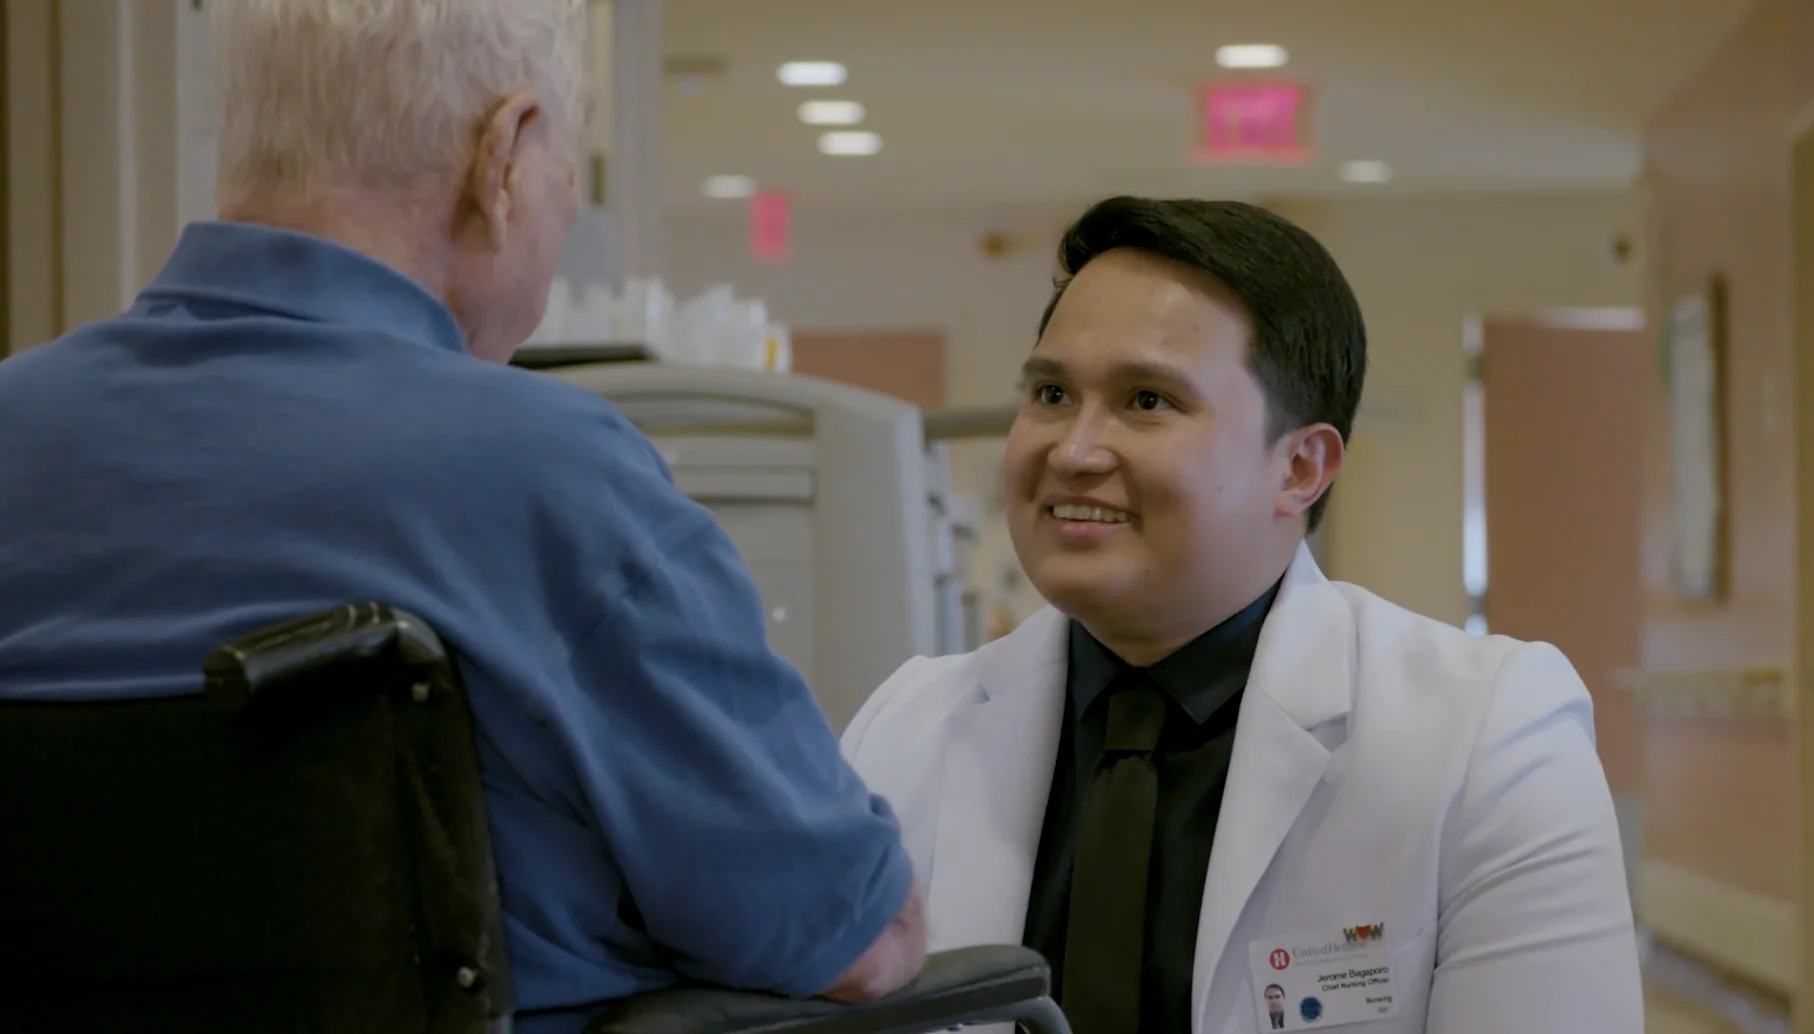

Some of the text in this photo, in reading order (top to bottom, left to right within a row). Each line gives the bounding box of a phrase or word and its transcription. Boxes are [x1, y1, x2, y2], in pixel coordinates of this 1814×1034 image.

[1317, 966, 1389, 983] Jerome Bagaporo
[1322, 983, 1340, 992] Chief
[1341, 981, 1366, 989] Nursing
[1366, 996, 1392, 1004] Nursing
